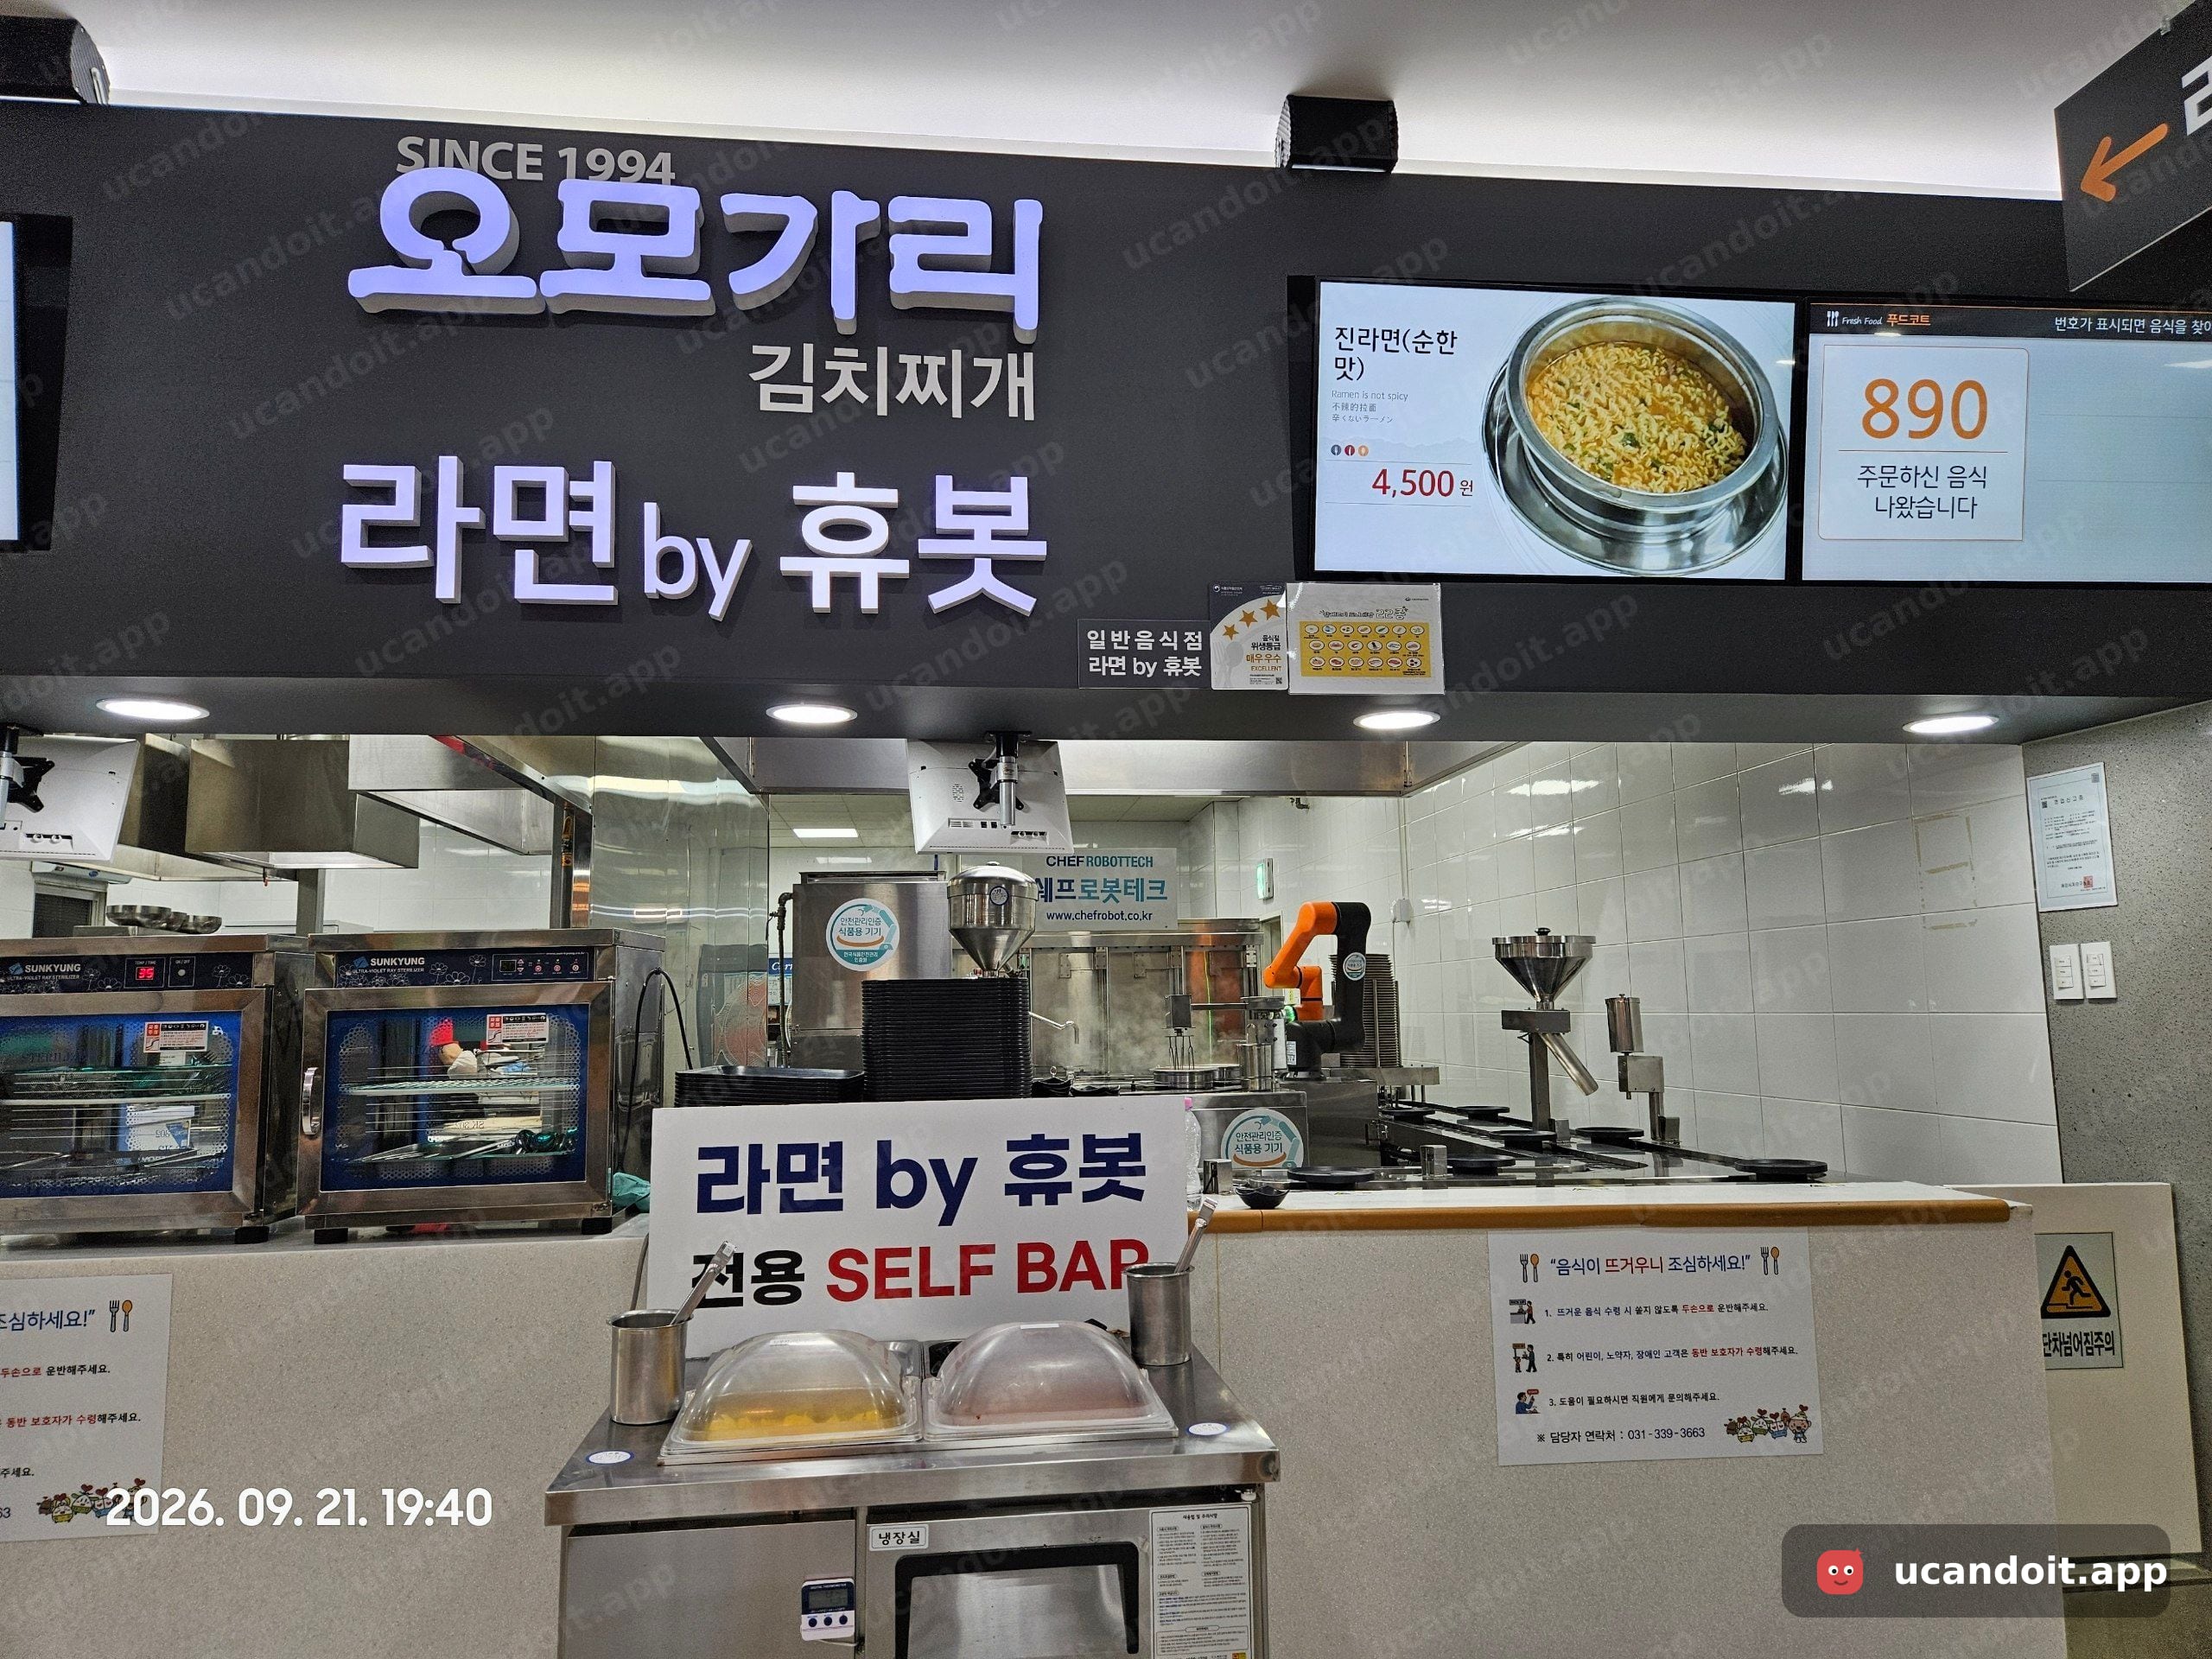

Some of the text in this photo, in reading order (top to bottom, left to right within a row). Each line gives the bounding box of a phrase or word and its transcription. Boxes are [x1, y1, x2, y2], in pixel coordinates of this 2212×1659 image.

[396, 135, 676, 185] SINCE 1994
[347, 166, 1044, 344] 오모가리
[1841, 313, 1931, 327] Fresh Food 푸드코트
[2054, 316, 2092, 333] 번호가
[2095, 317, 2146, 334] 표시되면
[2149, 318, 2187, 335] 음식을
[1333, 326, 1459, 356] 진라면(순한
[1333, 355, 1365, 381] 맛)
[748, 343, 1036, 421] 김치찌개
[1331, 389, 1409, 405] Ramen is not spicy
[1861, 378, 1988, 440] 890
[1371, 467, 1474, 500] 4,500 원
[1857, 465, 1987, 490] 주문하신 음식
[1874, 495, 1978, 519] 나왔습니다
[340, 455, 1047, 622] 라면 by 휴봇
[1088, 656, 1202, 679] 라면 by 휴봇
[840, 917, 882, 926] 안전관리인증
[1046, 910, 1154, 921] www.chefrobot.co.kr
[838, 926, 881, 937] 식품용 기기
[24, 963, 81, 973] SUNKYUNG
[370, 957, 425, 966] SUNKYUNG
[1236, 1130, 1282, 1142] 안전관리인증
[1235, 1142, 1282, 1155] 식품용 기기
[696, 1132, 1147, 1227] 라면 by 휴봇
[826, 1243, 996, 1303] SELF
[1605, 1256, 1664, 1274] 뜨거우니
[1544, 1309, 1552, 1318] 1.
[1557, 1306, 1582, 1317] 뜨거운
[1585, 1306, 1601, 1317] 음식
[1604, 1306, 1621, 1316] 수령
[1624, 1305, 1632, 1316] 시
[1654, 1304, 1679, 1315] 않도록
[1681, 1303, 1715, 1314] 두손으로
[1718, 1302, 1769, 1313] 운반해주세요.
[1547, 1345, 1798, 1363] 2. 특히 어린이, 노약자, 장애인 고객은 동반 보호자가 수령해주세요.
[45, 1363, 111, 1376] 운반해주세요.
[1548, 1392, 1720, 1407] 3. 도움이 필요하시면 직원에게 문의해주세요.
[5, 1415, 27, 1428] 동반
[30, 1414, 73, 1427] 보호자가
[76, 1412, 142, 1425] 수령해주세요.
[1549, 1431, 1581, 1444] 담당자
[1584, 1430, 1616, 1442] 연락처
[1627, 1427, 1706, 1440] 031-339-3663
[877, 1530, 922, 1547] 냉장실
